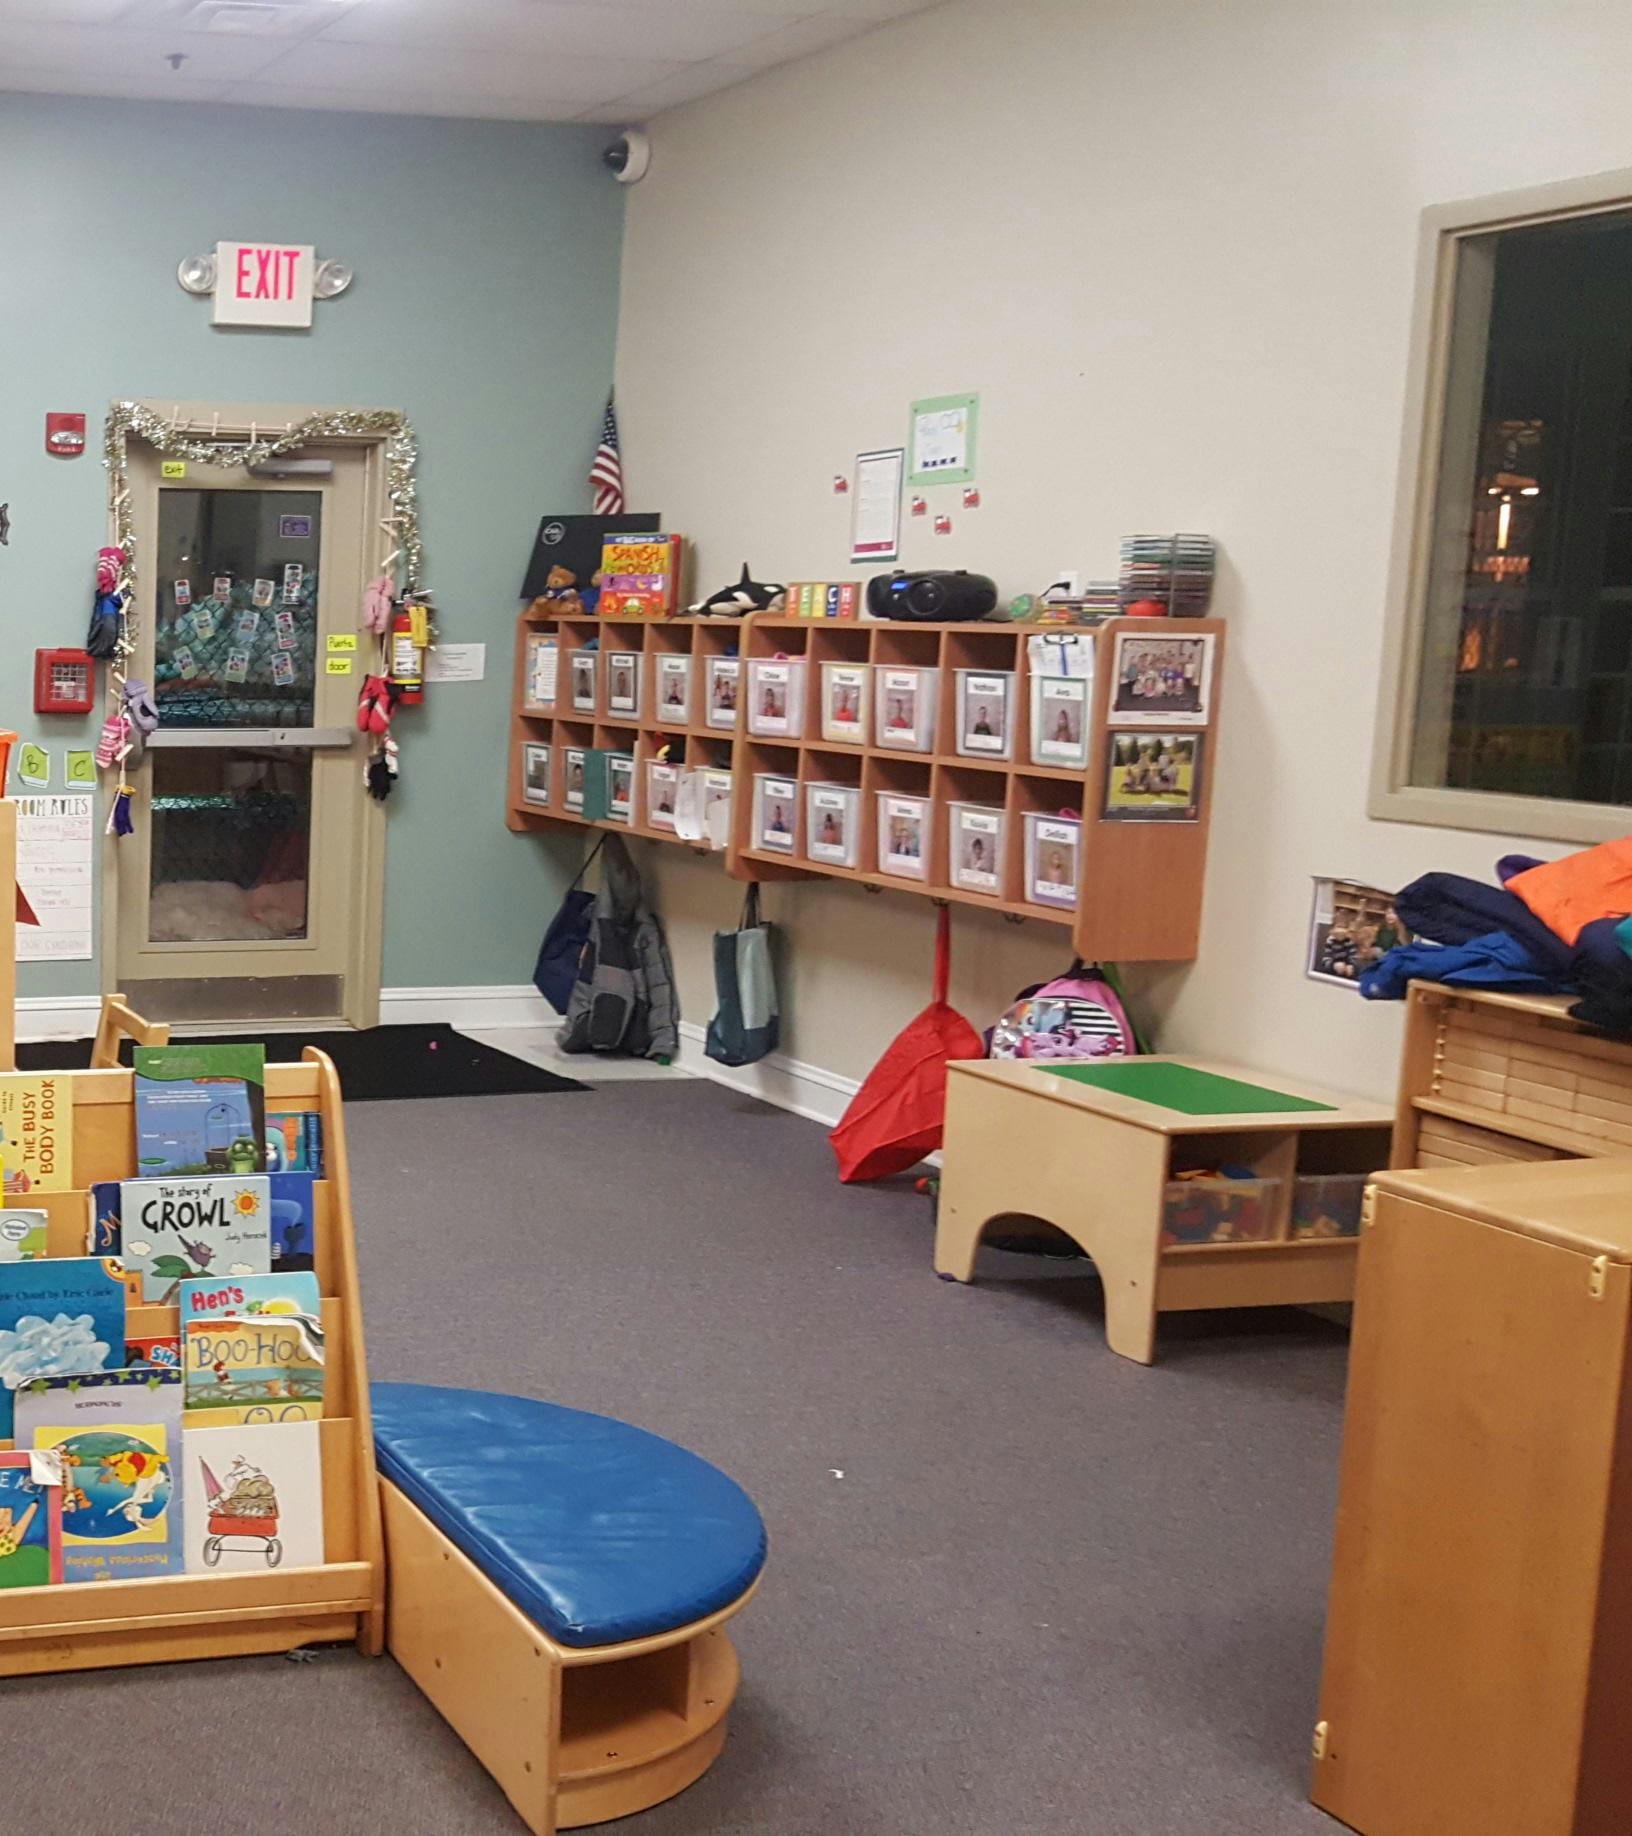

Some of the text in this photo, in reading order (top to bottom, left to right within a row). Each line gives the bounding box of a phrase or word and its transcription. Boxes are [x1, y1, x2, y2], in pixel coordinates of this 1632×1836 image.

[236, 249, 300, 300] EXIT
[25, 753, 39, 774] B
[73, 758, 86, 780] C
[51, 798, 88, 815] RULES
[23, 1092, 36, 1162] THE BUSY
[39, 1080, 55, 1174] BODY BOOK
[159, 1184, 213, 1200] The story of
[141, 1198, 231, 1234] GROWL
[190, 1285, 244, 1312] Hen's
